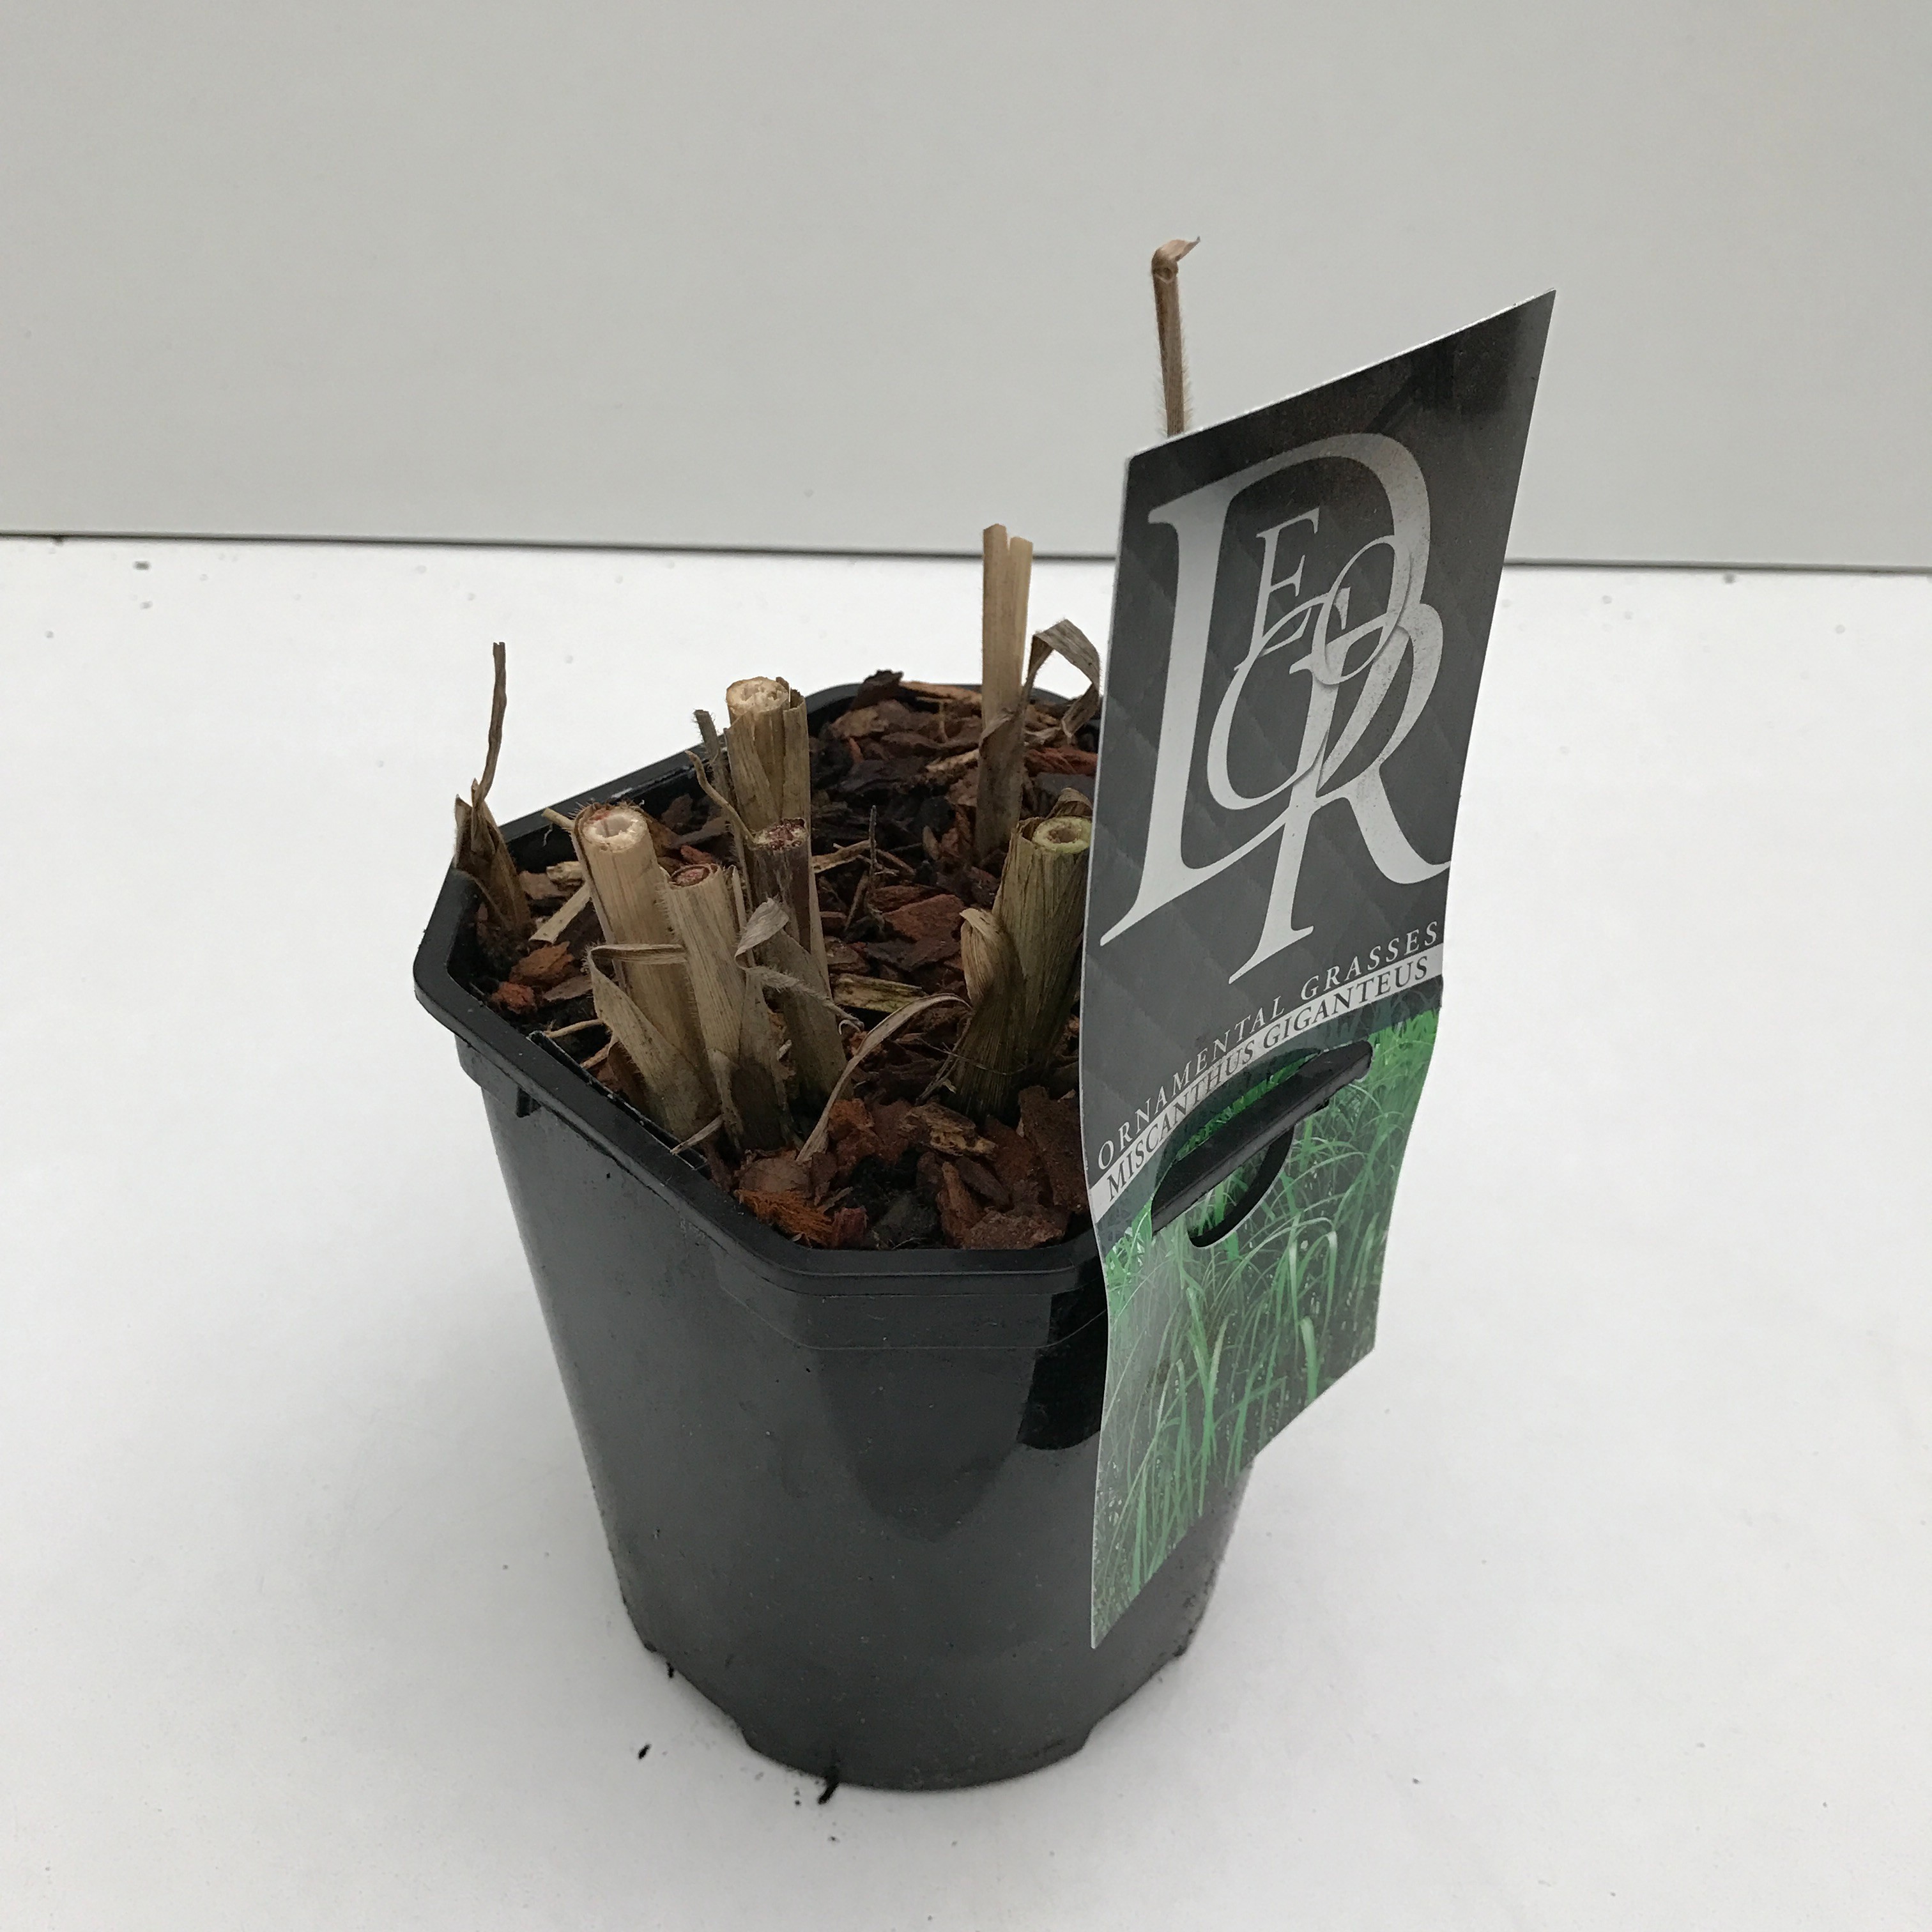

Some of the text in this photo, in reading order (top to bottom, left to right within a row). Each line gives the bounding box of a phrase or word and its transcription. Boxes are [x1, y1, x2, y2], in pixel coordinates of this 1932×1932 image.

[1098, 921, 1438, 1170] ORNAMENTAL GRASSES
[1106, 955, 1428, 1202] MISCANTHUS GIGANTEUS
